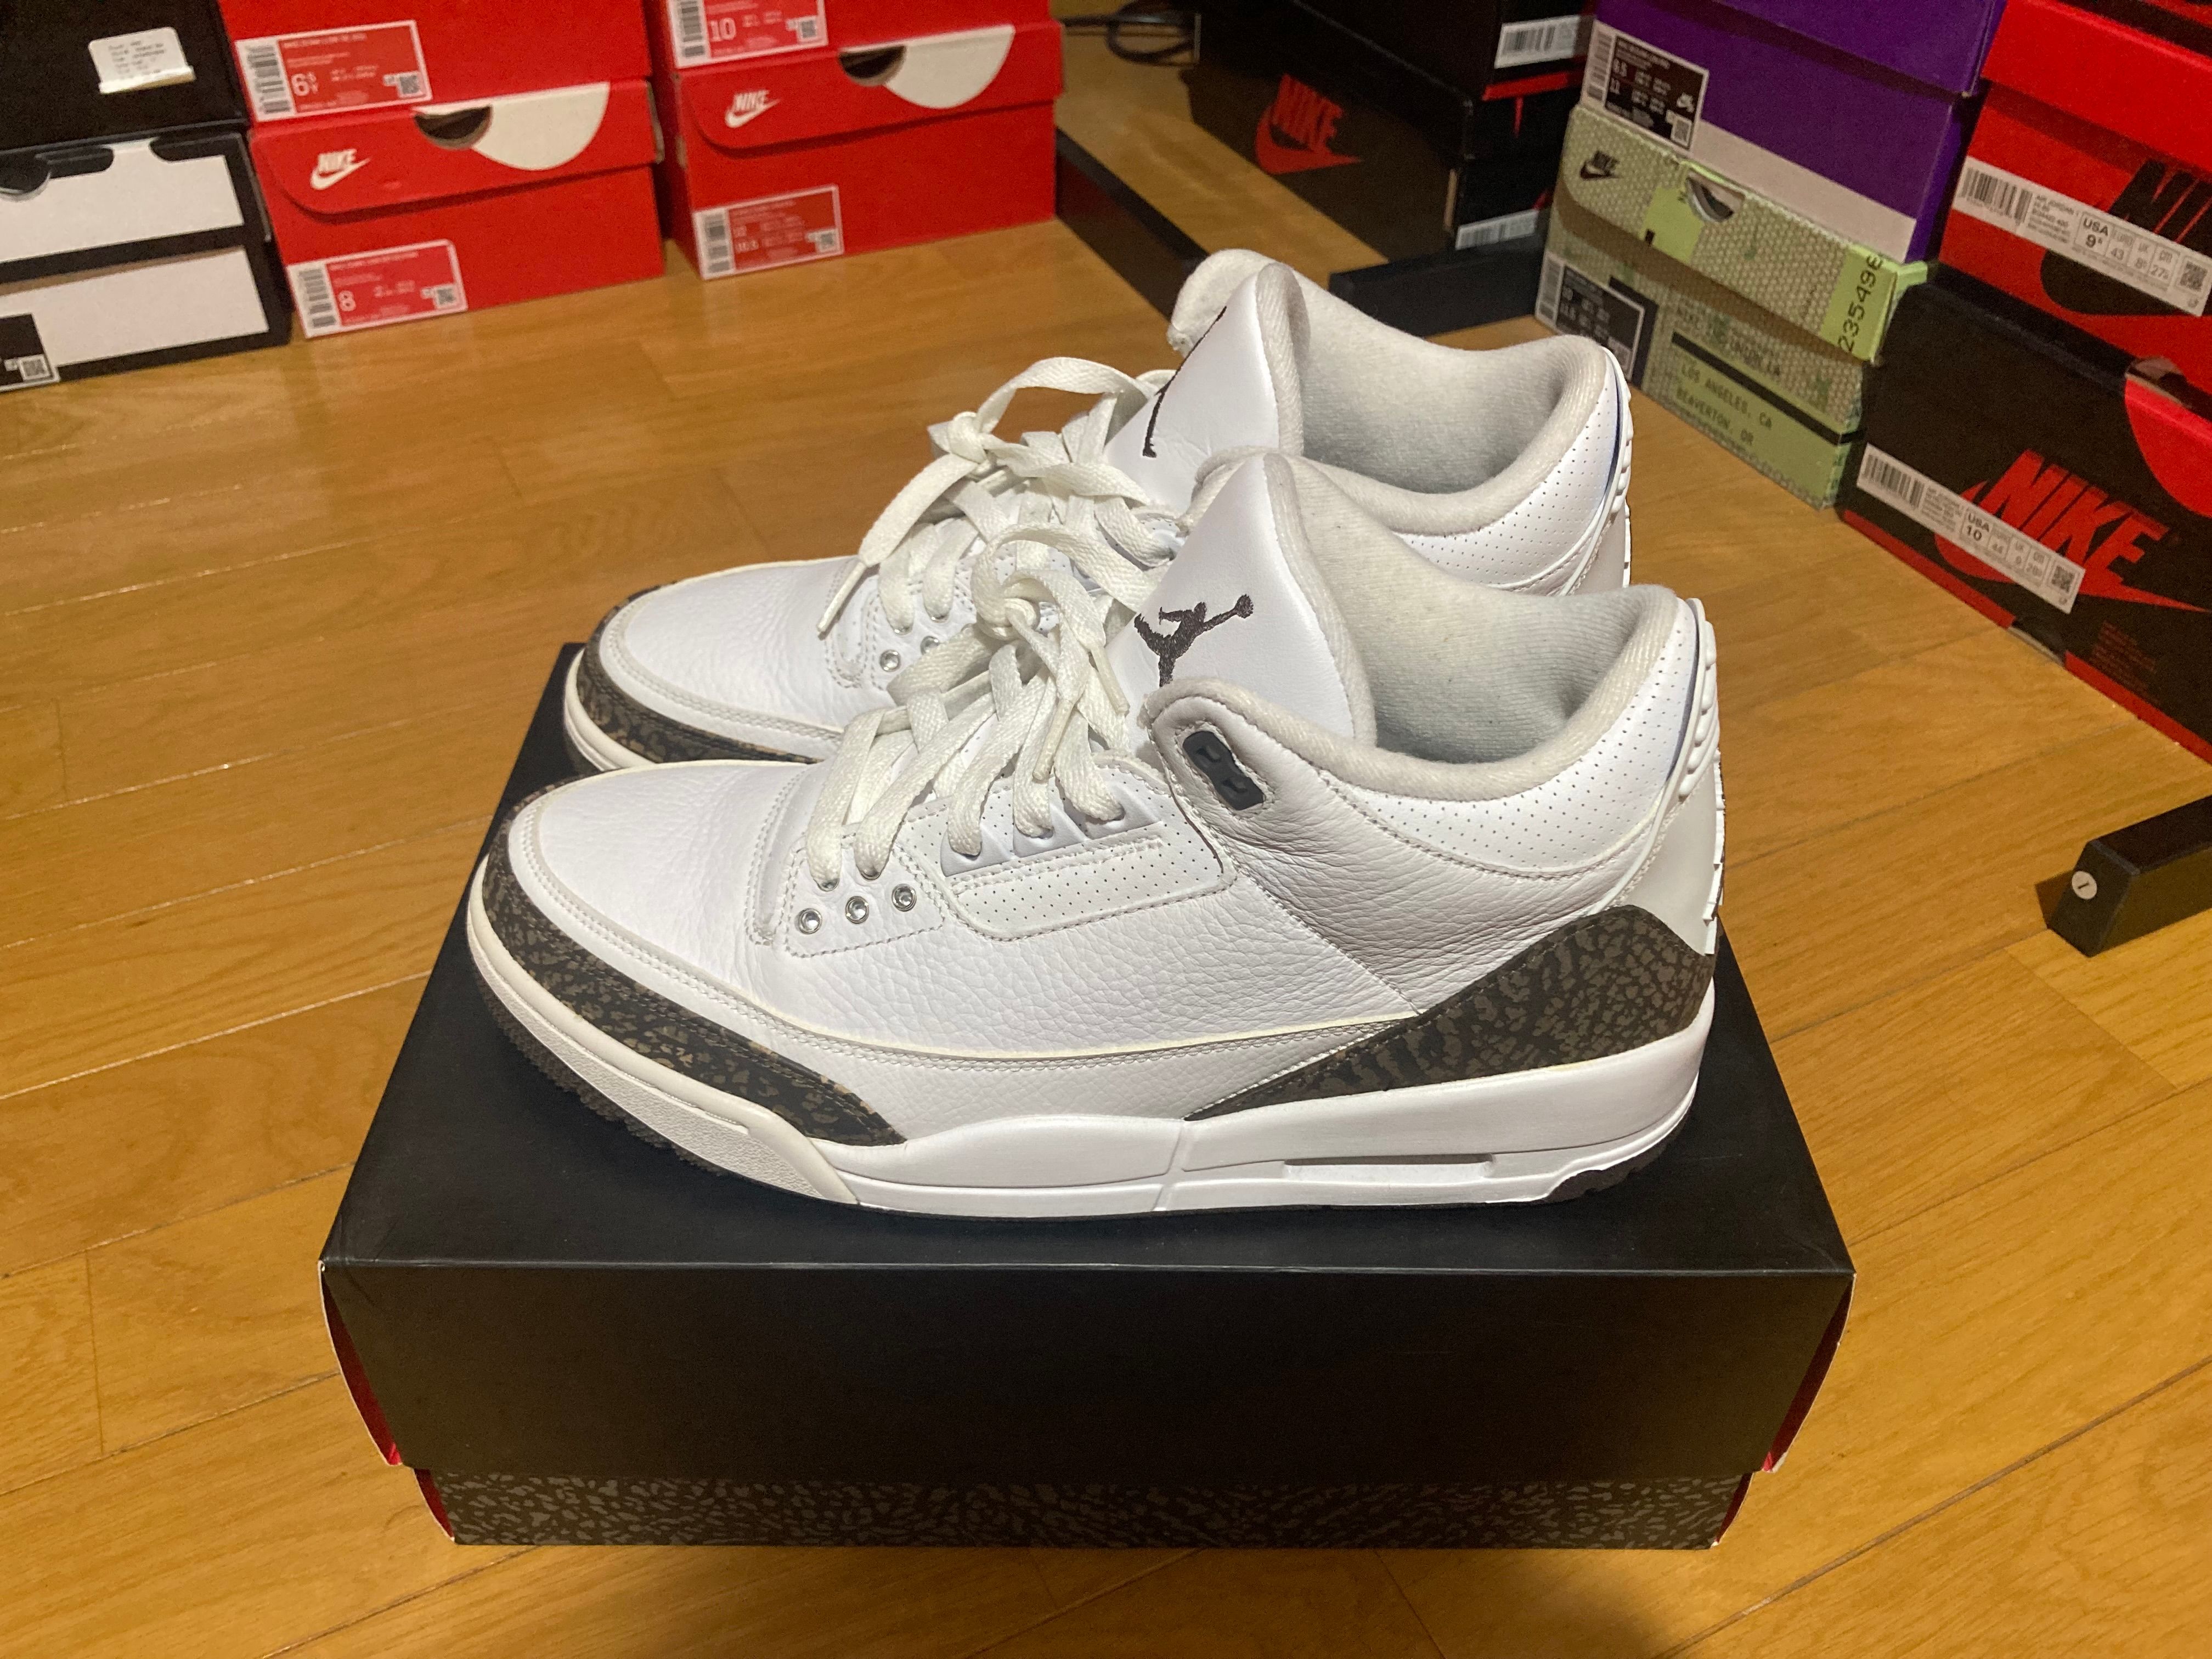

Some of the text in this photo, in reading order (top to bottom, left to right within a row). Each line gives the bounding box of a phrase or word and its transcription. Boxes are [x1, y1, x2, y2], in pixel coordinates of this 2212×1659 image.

[709, 18, 737, 42] 10
[733, 89, 770, 111] NIKE
[1272, 72, 1343, 155] NIKE
[2083, 217, 2109, 237] USA
[337, 290, 357, 312] 8
[1968, 512, 1990, 532] USA
[1979, 448, 2170, 586] NIKE
[1966, 524, 1982, 541] 10
